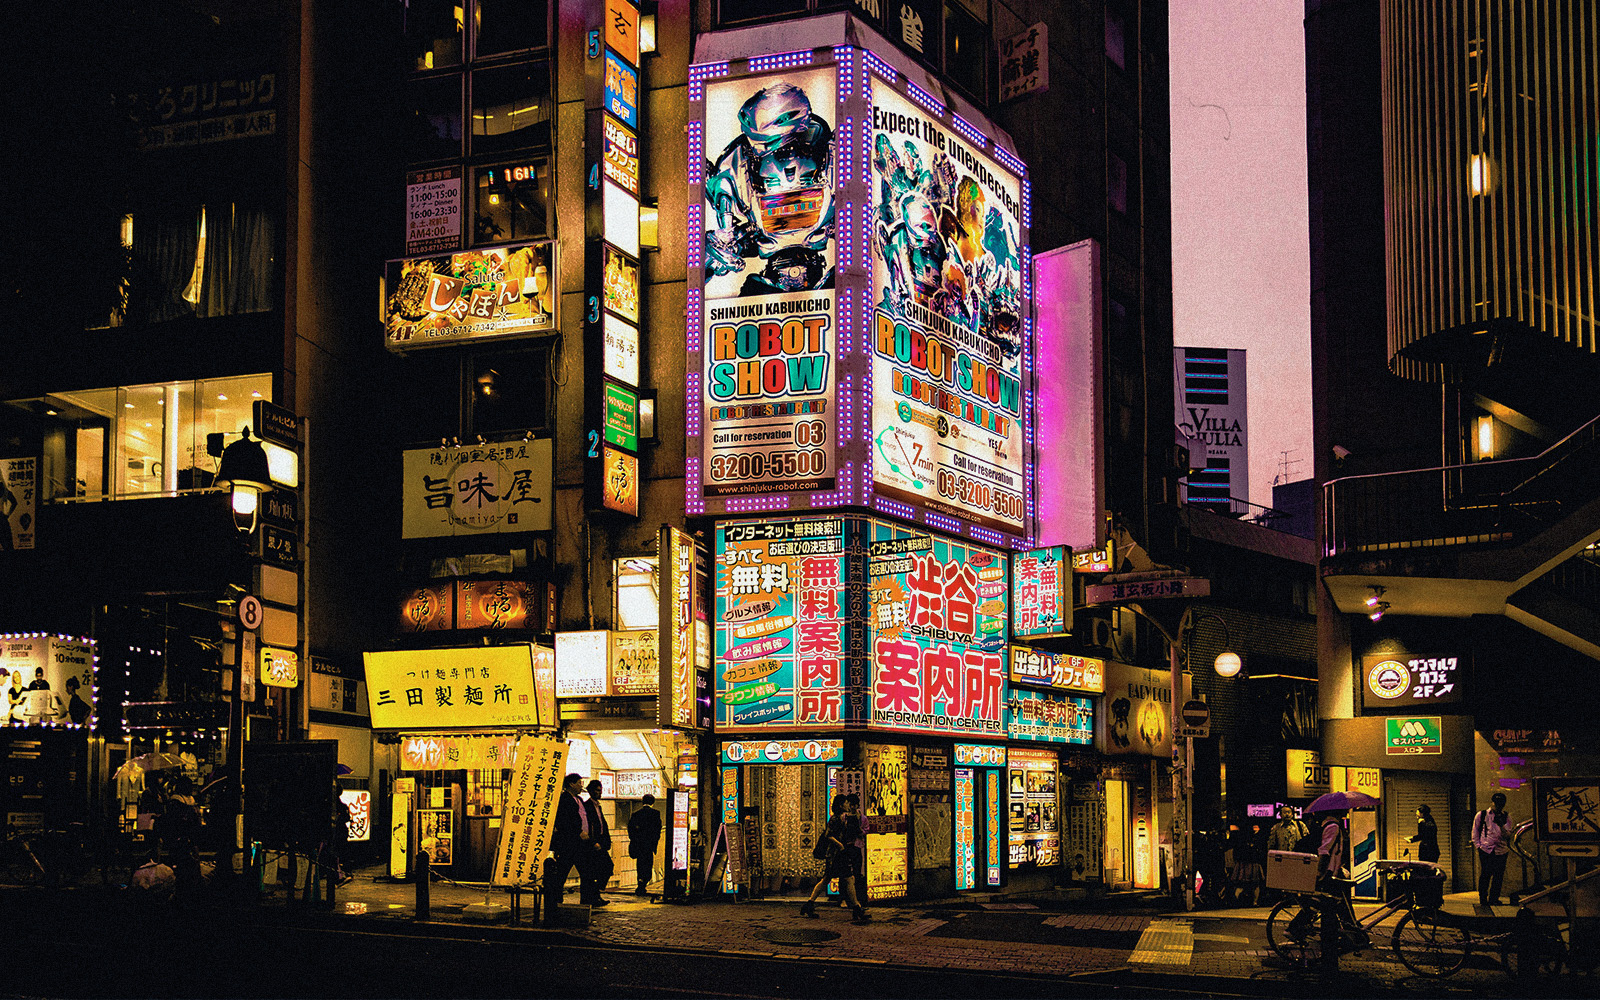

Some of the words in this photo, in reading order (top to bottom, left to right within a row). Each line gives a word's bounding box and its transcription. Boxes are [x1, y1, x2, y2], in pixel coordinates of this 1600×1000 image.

[588, 30, 600, 57] 5
[604, 57, 637, 108] 麻雀
[1004, 77, 1038, 97] チャイナ
[611, 98, 630, 120] 5F
[605, 121, 637, 154] 出会い
[608, 143, 636, 174] カフェ
[873, 107, 920, 142] Expect
[922, 121, 946, 151] the
[948, 138, 1020, 223] unexpected
[416, 169, 452, 182] 営業時間
[588, 163, 599, 190] 4
[410, 189, 457, 203] 11:00-15:00
[428, 183, 445, 191] Lunch
[410, 205, 457, 219] 16:00-23:30
[409, 226, 446, 240] AM4:00
[464, 271, 504, 285] Salute
[430, 277, 520, 319] じゃぽん
[710, 304, 763, 320] SHINJUKU
[765, 298, 830, 315] KABUKICHO
[589, 296, 600, 323] 3
[389, 325, 418, 342] 4F
[424, 323, 495, 337] TEL03-6712-7342
[714, 318, 825, 361] ROBOT
[905, 300, 951, 338] SHINJUKU
[952, 322, 1000, 361] KABUKICHO
[877, 313, 956, 384] ROBOT
[957, 351, 1019, 413] SHOW
[713, 355, 825, 397] SHOW
[712, 405, 750, 421] ROBOT
[751, 400, 826, 418] RESTAURANT
[893, 368, 938, 407] ROBOT
[937, 389, 1010, 438] RESTAURANT
[1187, 407, 1243, 433] VILLA
[588, 429, 600, 458] 2
[713, 433, 730, 445] Call
[730, 431, 742, 443] for
[744, 429, 792, 442] reservation
[797, 421, 825, 445] 03
[713, 450, 824, 479] 3200-5500
[912, 443, 924, 466] 7
[918, 457, 934, 472] min
[953, 452, 967, 469] Call
[967, 457, 977, 472] for
[977, 461, 1014, 487] reservation
[24, 489, 34, 499] 2F
[422, 469, 542, 509] 旨味屋
[717, 482, 819, 495] www.shinjuku-robot.com
[938, 470, 1024, 521] 03-3200-5500
[924, 500, 983, 523] www.shinjuku-robot.com
[724, 548, 763, 565] すべて
[463, 582, 475, 591] 2F
[730, 562, 790, 595] 無料
[1113, 581, 1183, 598] 道玄坂小路
[870, 587, 891, 604] すべて
[906, 551, 978, 634] 渋谷
[1019, 556, 1039, 630] 案内所
[1040, 569, 1057, 615] 無料
[245, 600, 257, 624] 8
[411, 588, 430, 632] まるげん
[486, 582, 512, 630] まるげん
[725, 601, 772, 621] グルメ情報
[877, 601, 910, 629] 無料
[798, 556, 842, 723] 無料案内所
[910, 624, 974, 645] SHIBUYA
[732, 639, 784, 660] 飲み屋情報
[406, 667, 491, 680] つけ麺専門店
[727, 660, 778, 681] カフェ情報
[1014, 650, 1053, 678] 出会い
[1052, 664, 1083, 688] カフェ
[1069, 656, 1085, 668] 6F
[1407, 657, 1458, 672] サンマルク
[82, 674, 91, 686] 2F
[874, 637, 1003, 719] 案内所
[377, 683, 513, 707] 三田製麺所
[724, 682, 777, 704] タウン情報
[1128, 683, 1150, 700] BABY
[1413, 685, 1434, 698] 2F
[874, 709, 955, 726] INFORMATION
[956, 715, 1002, 730] CENTER
[1022, 697, 1078, 725] 無料案内所
[742, 742, 761, 750] トイレ
[1391, 737, 1436, 747] モスバーガー
[1305, 766, 1330, 785] 209
[1357, 772, 1378, 787] 209
[1551, 822, 1587, 832] 横断禁止
[1008, 845, 1037, 864] 出会い
[1037, 849, 1060, 866] カフェ
